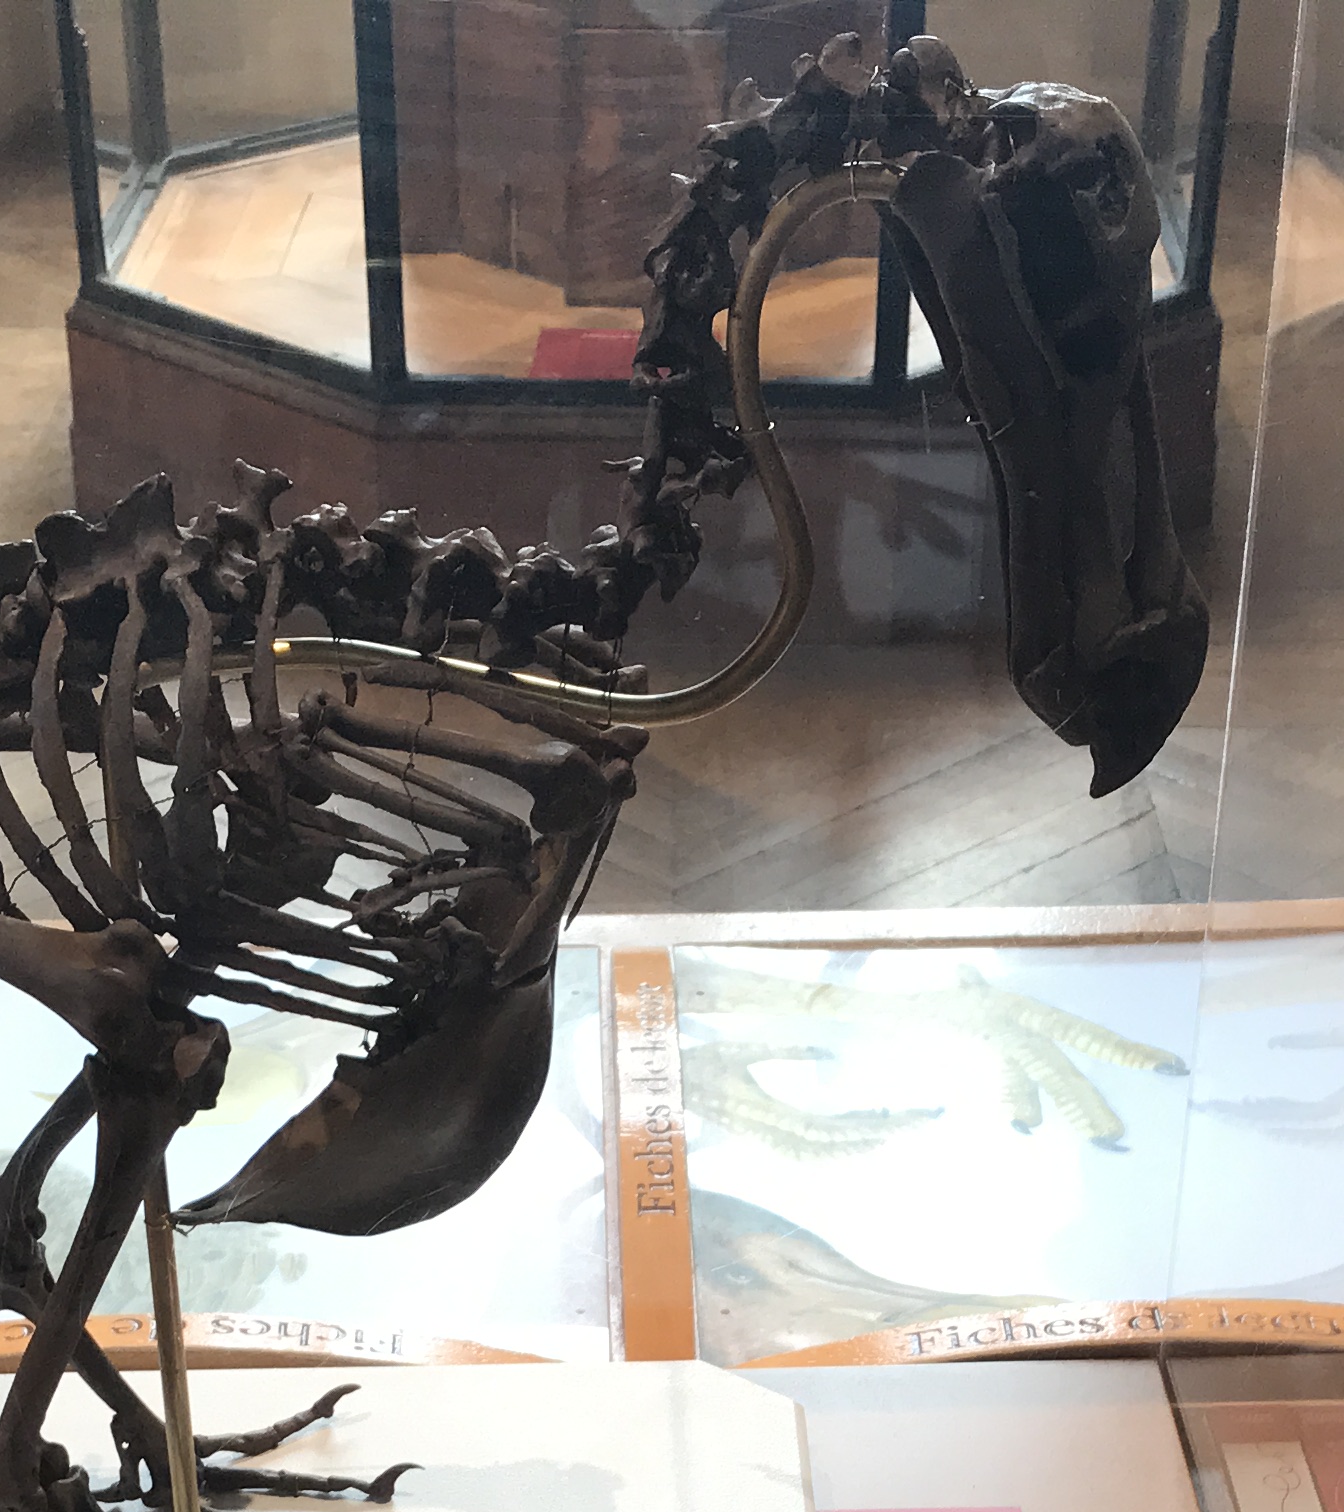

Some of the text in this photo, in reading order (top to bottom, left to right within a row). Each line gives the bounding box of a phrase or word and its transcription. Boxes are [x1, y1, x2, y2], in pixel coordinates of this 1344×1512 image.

[634, 1104, 676, 1217] Fiches
[210, 1316, 404, 1356] Fiches
[906, 1306, 1105, 1357] Fiches
